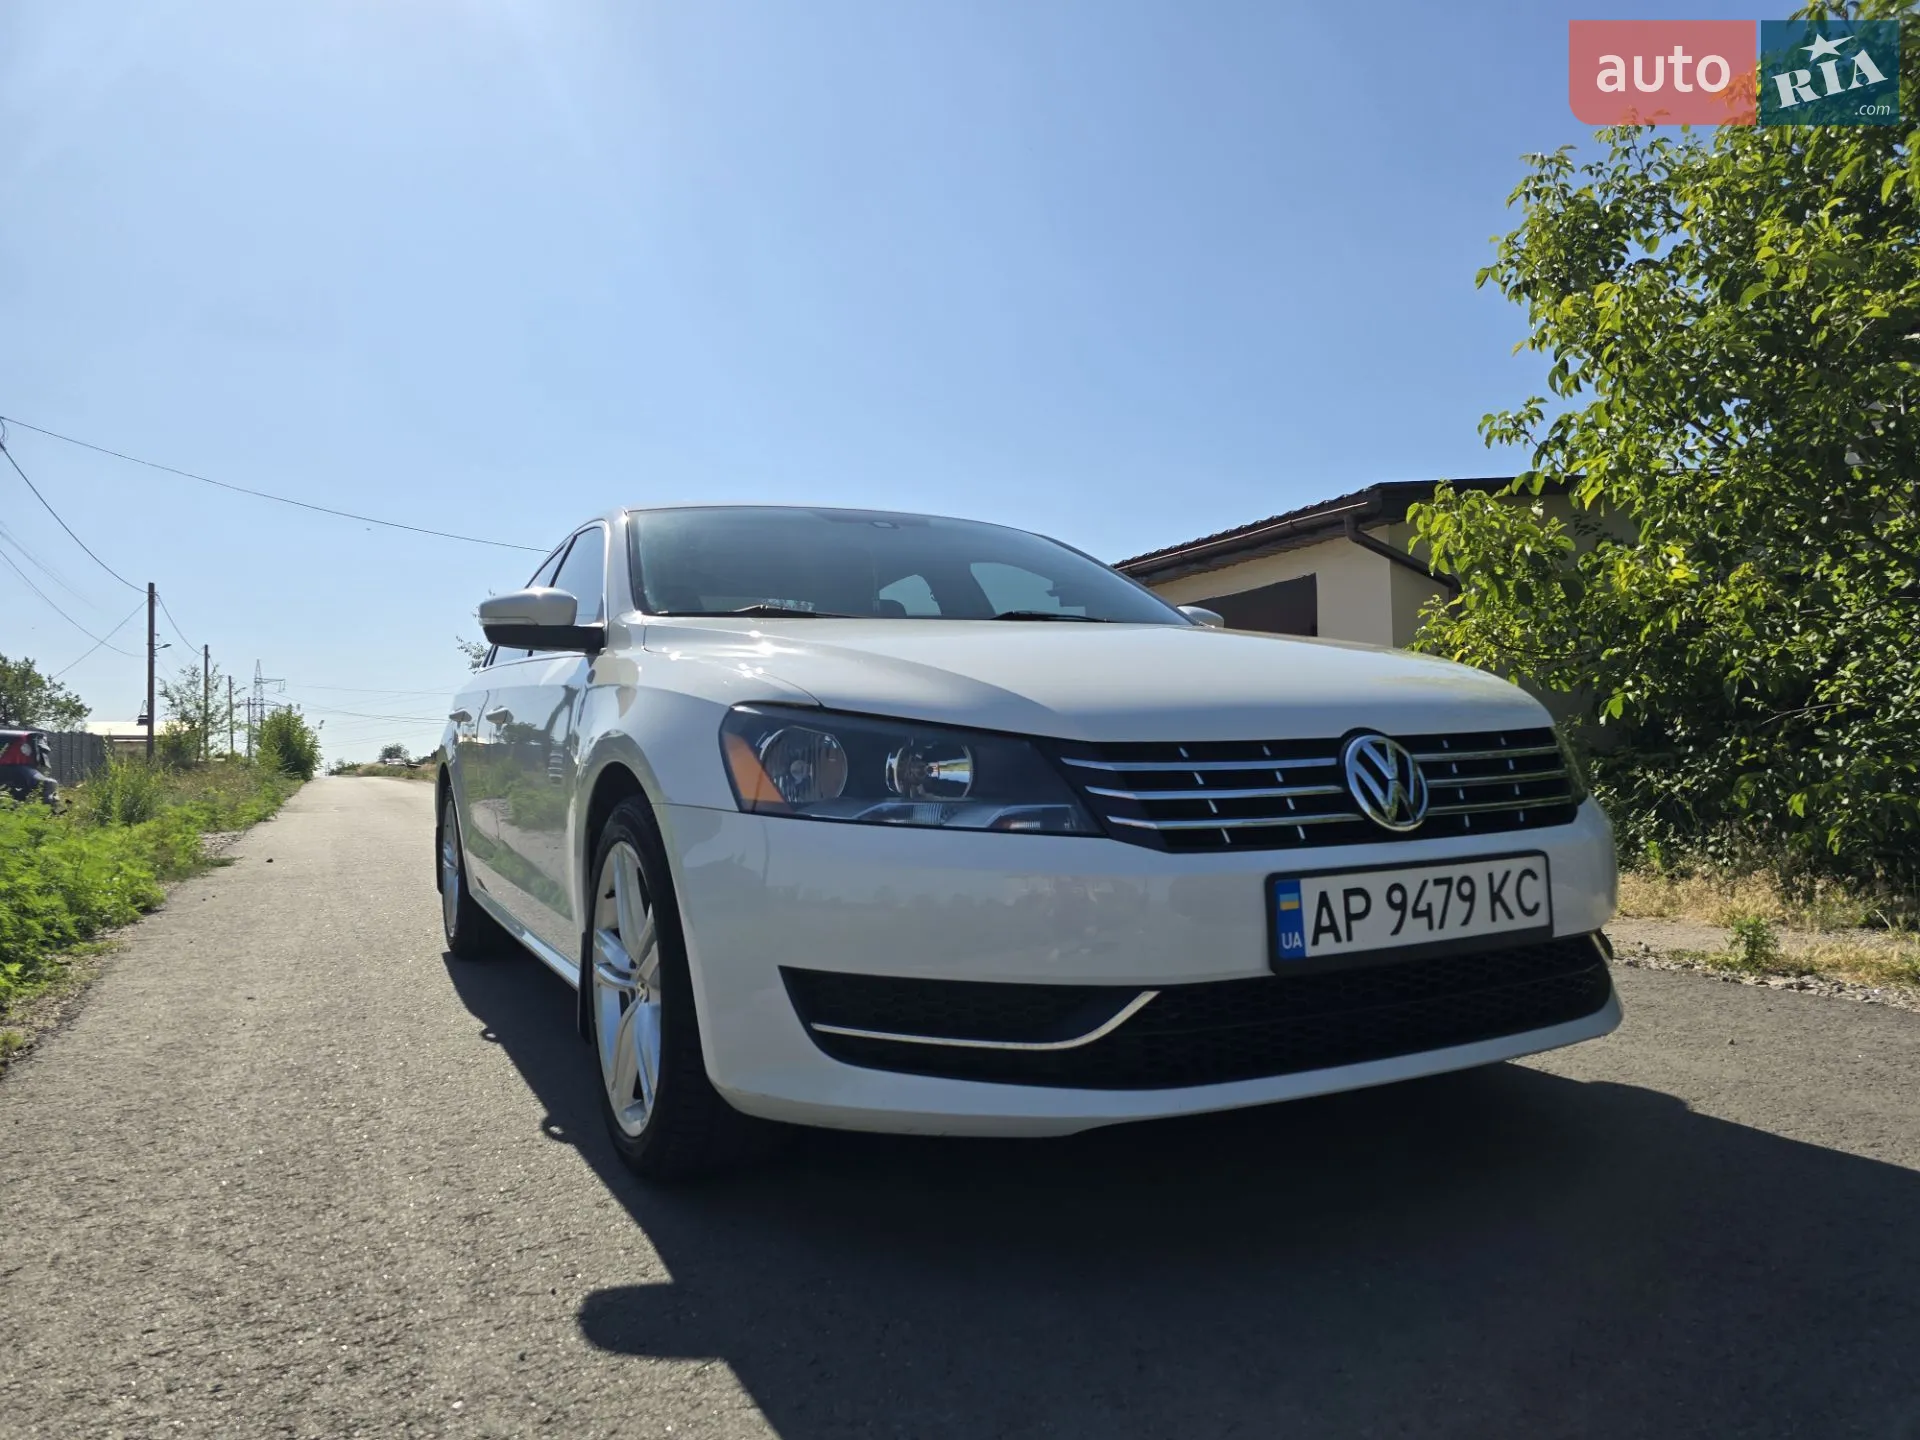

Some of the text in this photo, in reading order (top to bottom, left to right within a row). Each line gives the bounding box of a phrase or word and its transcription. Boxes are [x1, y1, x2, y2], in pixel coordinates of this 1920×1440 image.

[1311, 868, 1541, 947] AP 9479 KC
[1282, 932, 1303, 950] UA
